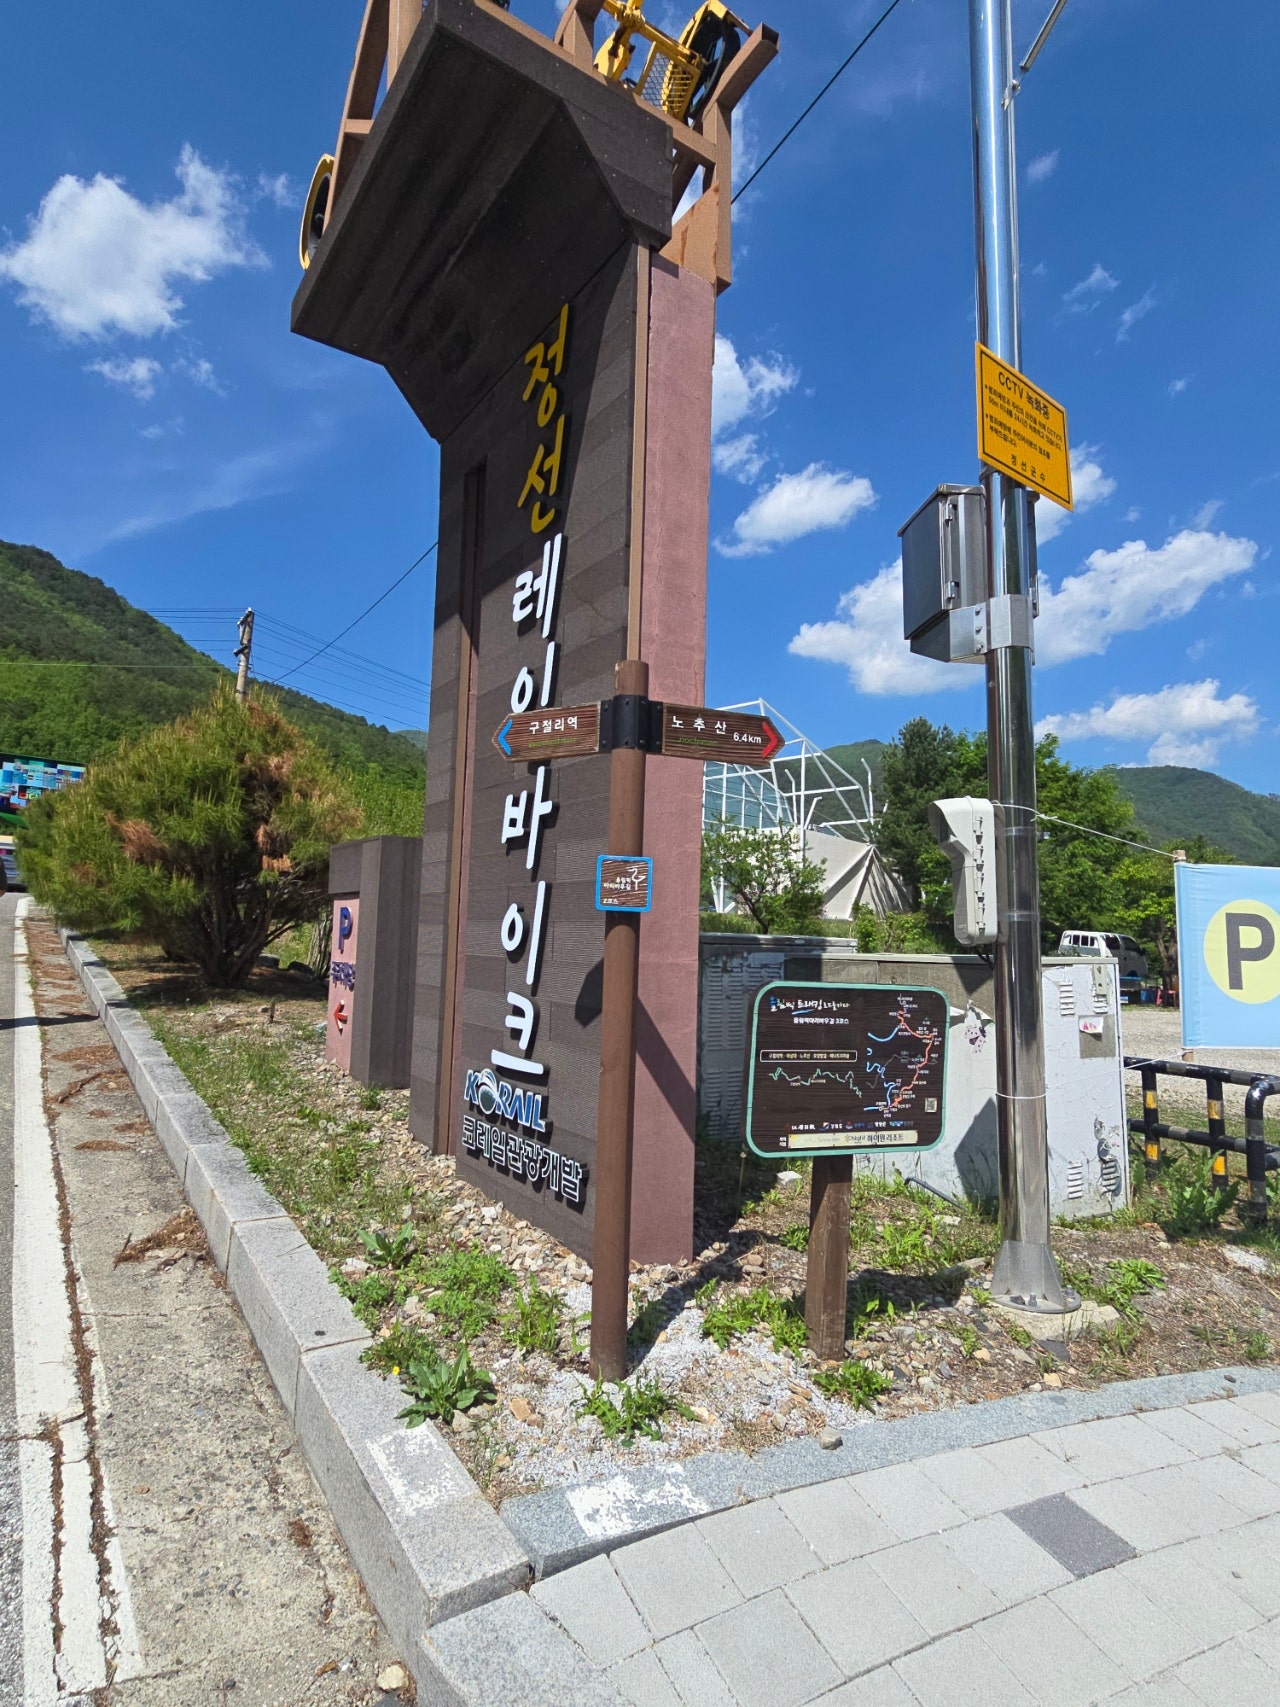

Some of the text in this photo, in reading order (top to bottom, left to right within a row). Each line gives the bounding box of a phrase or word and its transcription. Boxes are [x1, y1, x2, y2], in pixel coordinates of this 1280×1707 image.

[998, 372, 1024, 399] CCTV
[518, 303, 569, 534] 정선
[529, 715, 578, 735] 구절리역
[733, 732, 762, 745] 6.4km
[338, 907, 353, 950] P
[1225, 912, 1276, 991] P
[463, 1068, 546, 1133] KORAIL
[462, 1115, 583, 1203] 코레일관광개발
